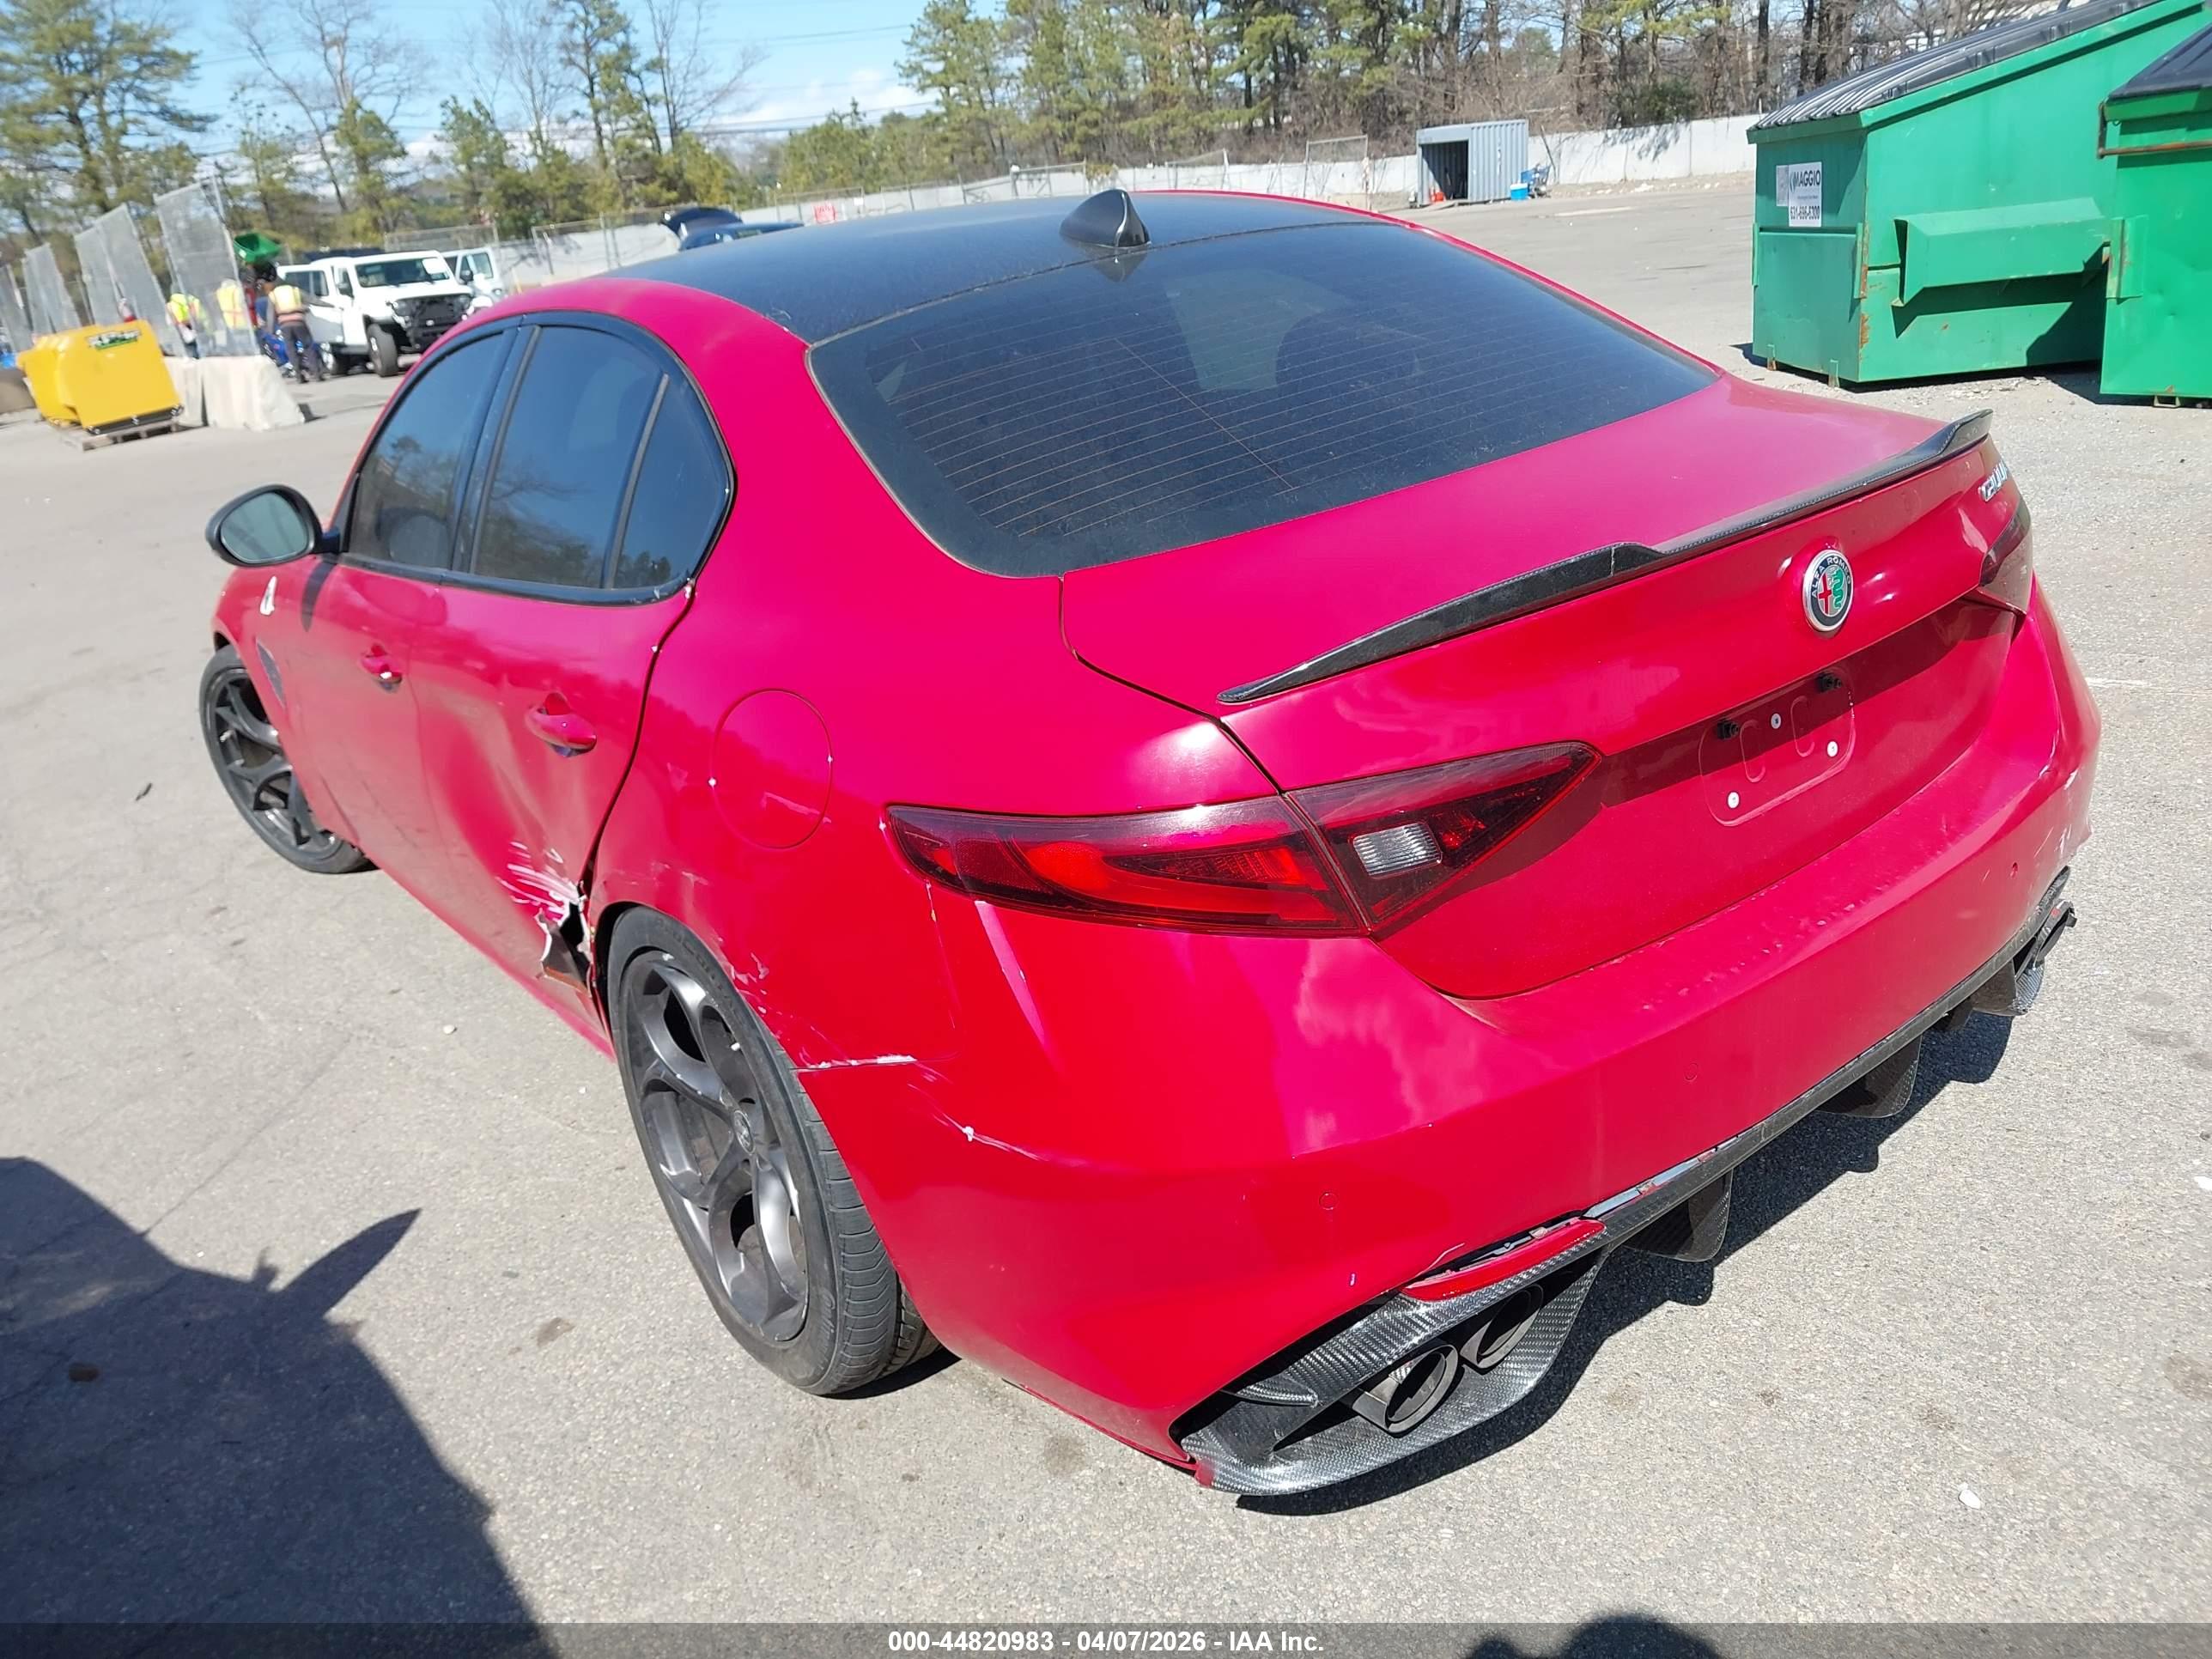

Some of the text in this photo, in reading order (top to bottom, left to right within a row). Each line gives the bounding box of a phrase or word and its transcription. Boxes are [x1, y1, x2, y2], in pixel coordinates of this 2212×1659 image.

[1793, 170, 1821, 187] MAGGIO
[1811, 556, 1851, 599] ALFA ROMEO
